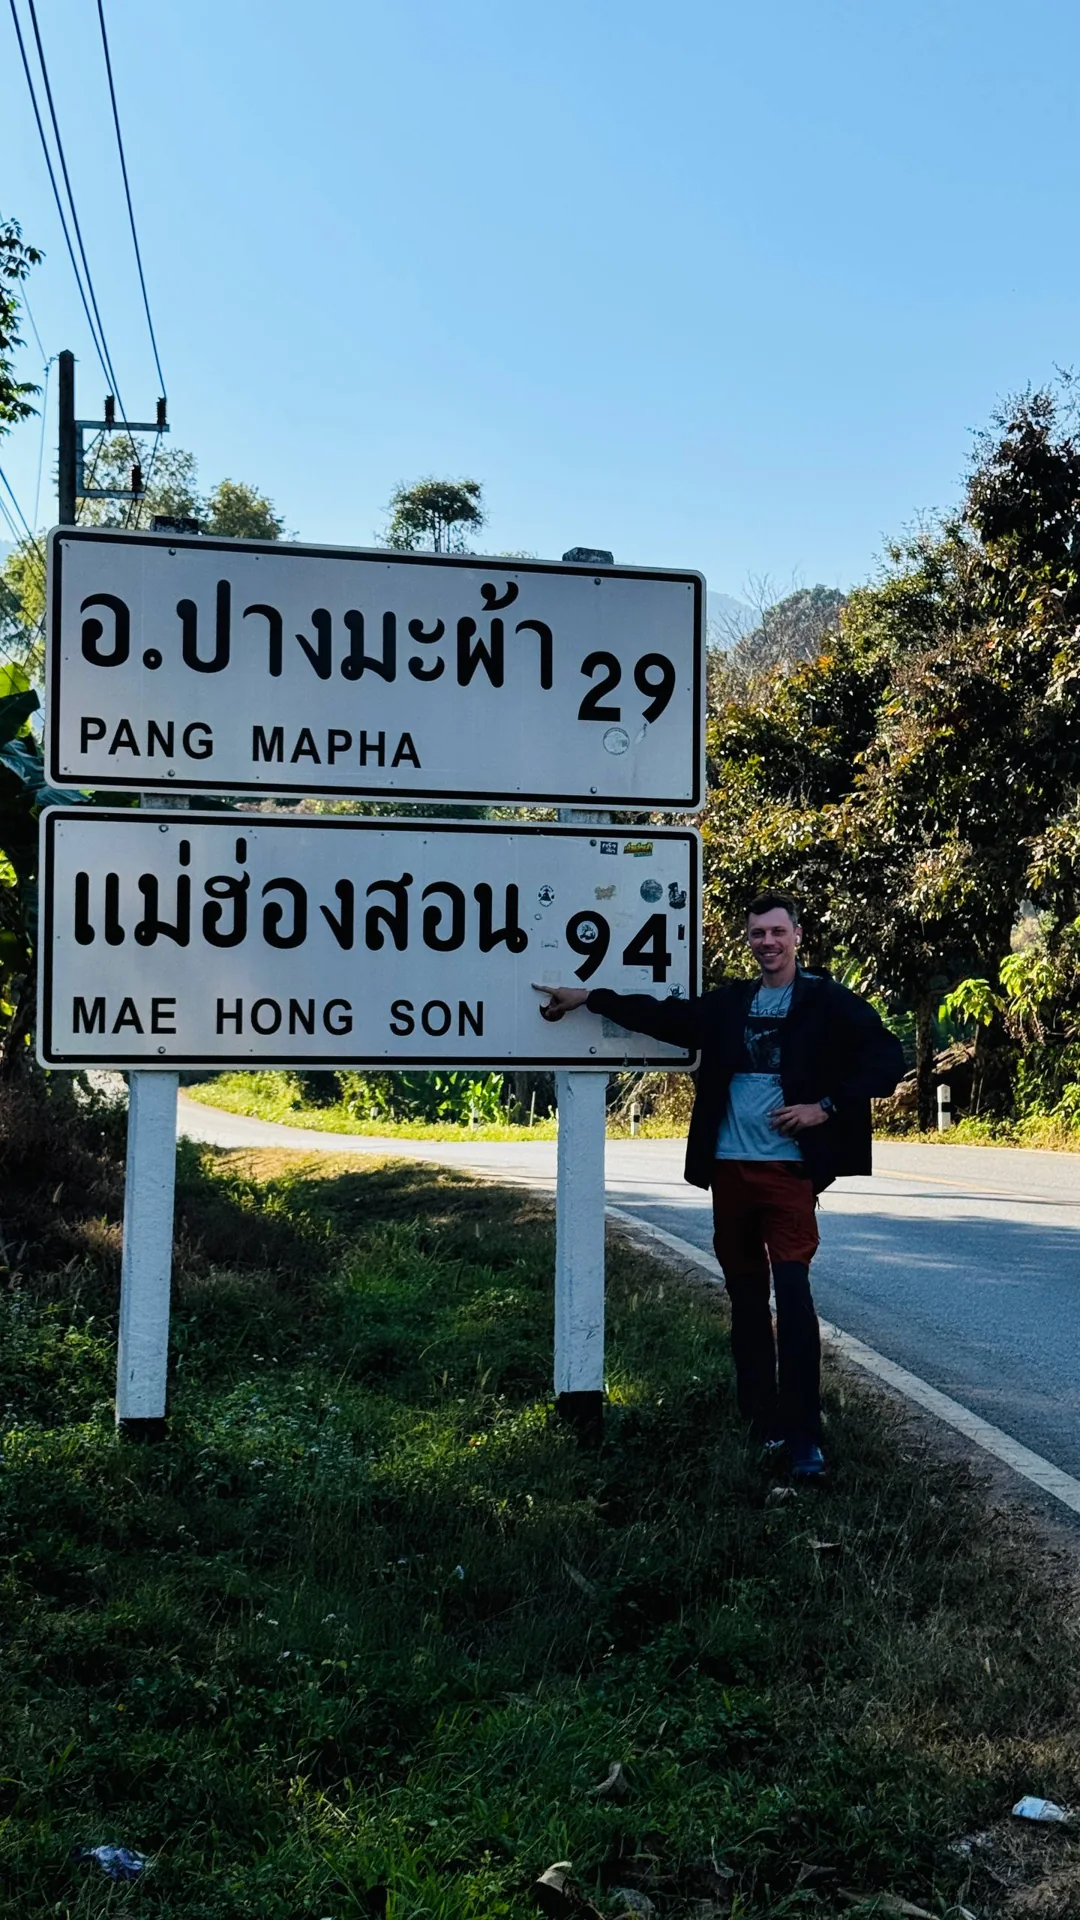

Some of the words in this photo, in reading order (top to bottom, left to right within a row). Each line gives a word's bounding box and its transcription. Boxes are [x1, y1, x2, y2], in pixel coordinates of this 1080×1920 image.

[79, 579, 554, 690] อ.ปางมะผ้า
[577, 650, 676, 725] 29
[80, 716, 214, 760] PANG
[252, 725, 422, 769] MAPHA
[74, 837, 529, 954] แม่ฮ่องสอน
[565, 910, 672, 983] 94
[72, 996, 177, 1035] MAE
[216, 997, 354, 1036] HONG
[389, 999, 485, 1037] SON
